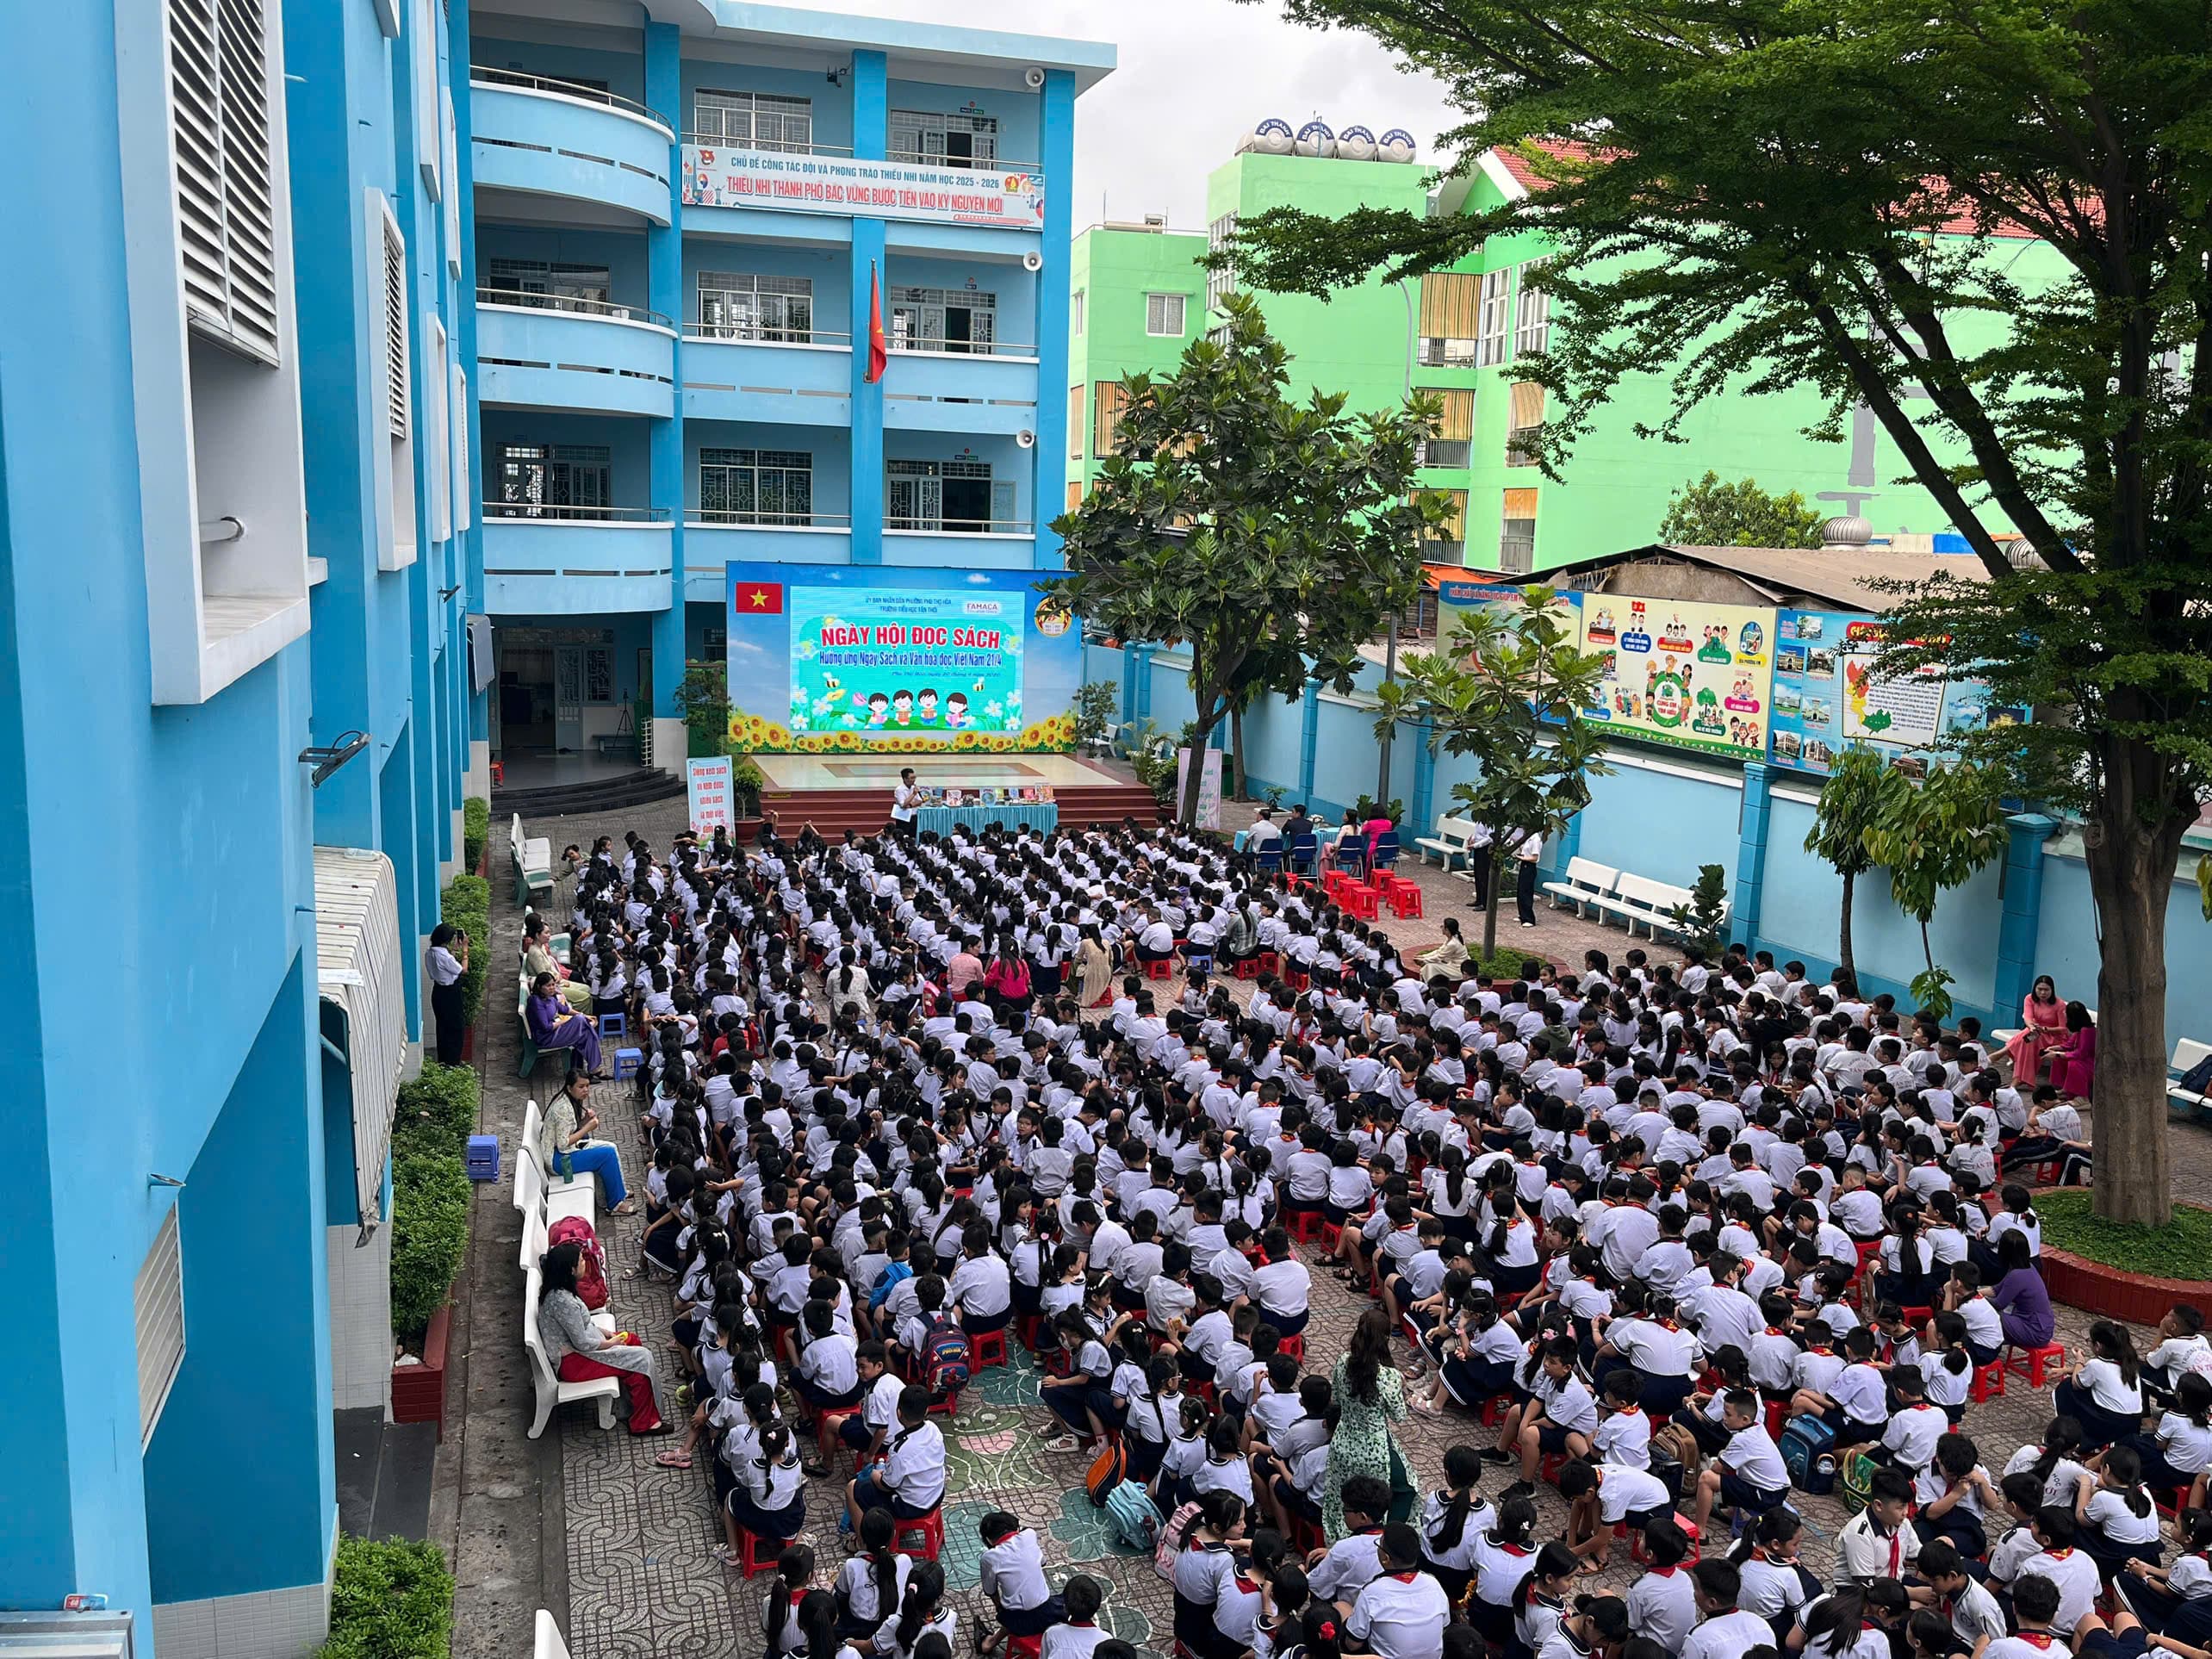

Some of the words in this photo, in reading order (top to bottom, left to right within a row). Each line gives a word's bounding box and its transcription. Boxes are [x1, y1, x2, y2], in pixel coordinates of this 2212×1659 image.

[731, 155, 748, 167] CHỦ
[749, 156, 760, 168] ĐỀ
[761, 158, 784, 171] CÔNG
[786, 159, 800, 172] TÁC
[803, 161, 816, 175] ĐỘI
[818, 161, 828, 174] VÀ
[830, 165, 856, 177] PHONG
[858, 167, 878, 179] TRÀO
[880, 168, 902, 181] THIẾU
[904, 171, 917, 182] NHI
[919, 172, 937, 183] NĂM
[939, 175, 954, 186] HỌC
[956, 177, 974, 187] 2025
[981, 178, 999, 189] 2026
[726, 174, 753, 195] THIẾU
[755, 178, 771, 196] NHI
[774, 178, 802, 198] THÀNH
[804, 180, 824, 200] PHỐ
[873, 186, 897, 207] BƯỚC
[898, 189, 917, 208] TIẾN
[919, 190, 936, 209] VÀO
[951, 194, 985, 214] NGUYÊN
[987, 196, 1003, 214] MỚI
[821, 623, 870, 646] NGÀY
[876, 623, 905, 648] HỘI
[911, 626, 948, 649] ĐỌC
[953, 625, 1000, 649] SÁCH
[860, 651, 877, 666] Ngày
[879, 650, 898, 665] Sách
[900, 652, 908, 665] và
[910, 651, 923, 665] Văn
[940, 652, 952, 668] đọc
[954, 652, 967, 668] Việt
[969, 653, 985, 666] Nam
[986, 653, 1001, 666] 21/4
